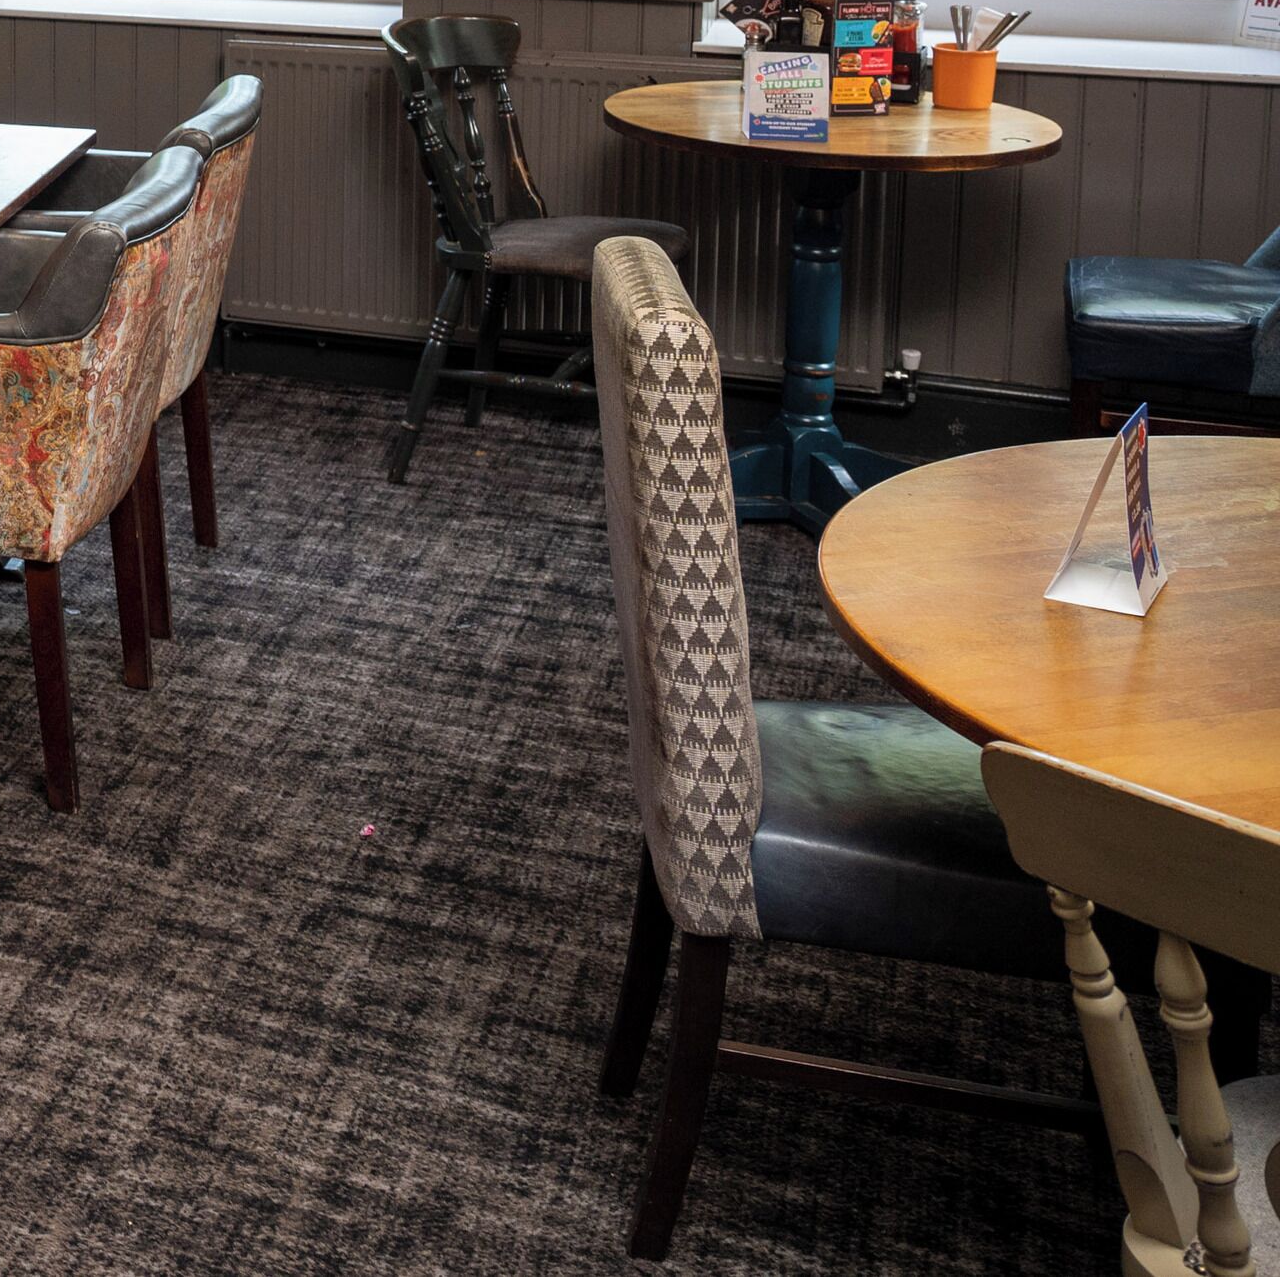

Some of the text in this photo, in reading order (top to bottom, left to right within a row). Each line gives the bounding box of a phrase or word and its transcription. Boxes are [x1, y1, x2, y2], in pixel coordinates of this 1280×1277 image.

[860, 4, 876, 14] HOT
[760, 55, 810, 74] CALLING
[780, 70, 802, 79] ALL
[760, 78, 822, 89] STUDENTS
